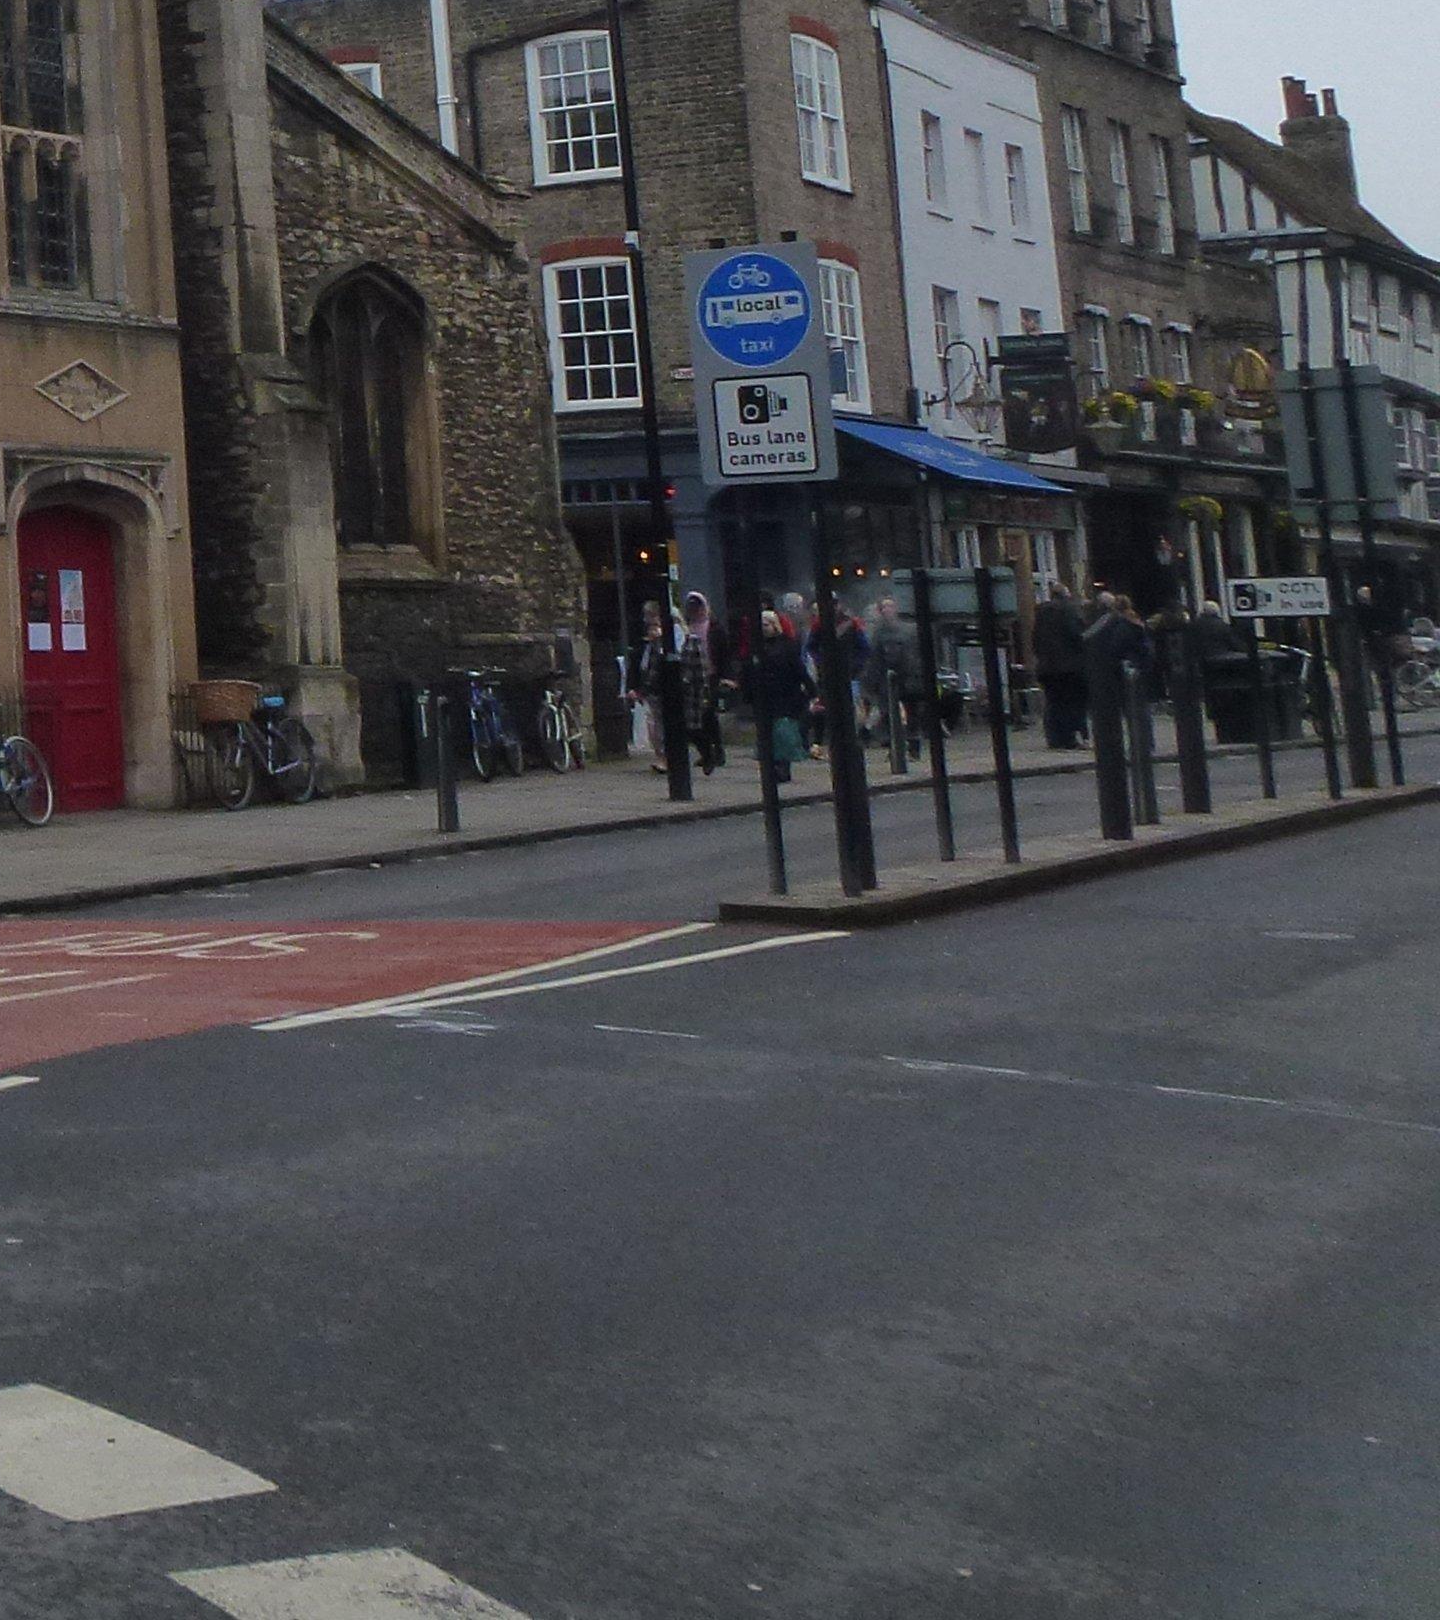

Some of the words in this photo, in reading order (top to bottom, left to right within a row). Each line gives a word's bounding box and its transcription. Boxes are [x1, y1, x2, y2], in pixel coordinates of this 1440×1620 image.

[736, 295, 782, 313] local
[740, 337, 775, 354] taxi
[727, 432, 761, 447] Bus
[767, 429, 806, 444] lane
[729, 449, 807, 466] cameras
